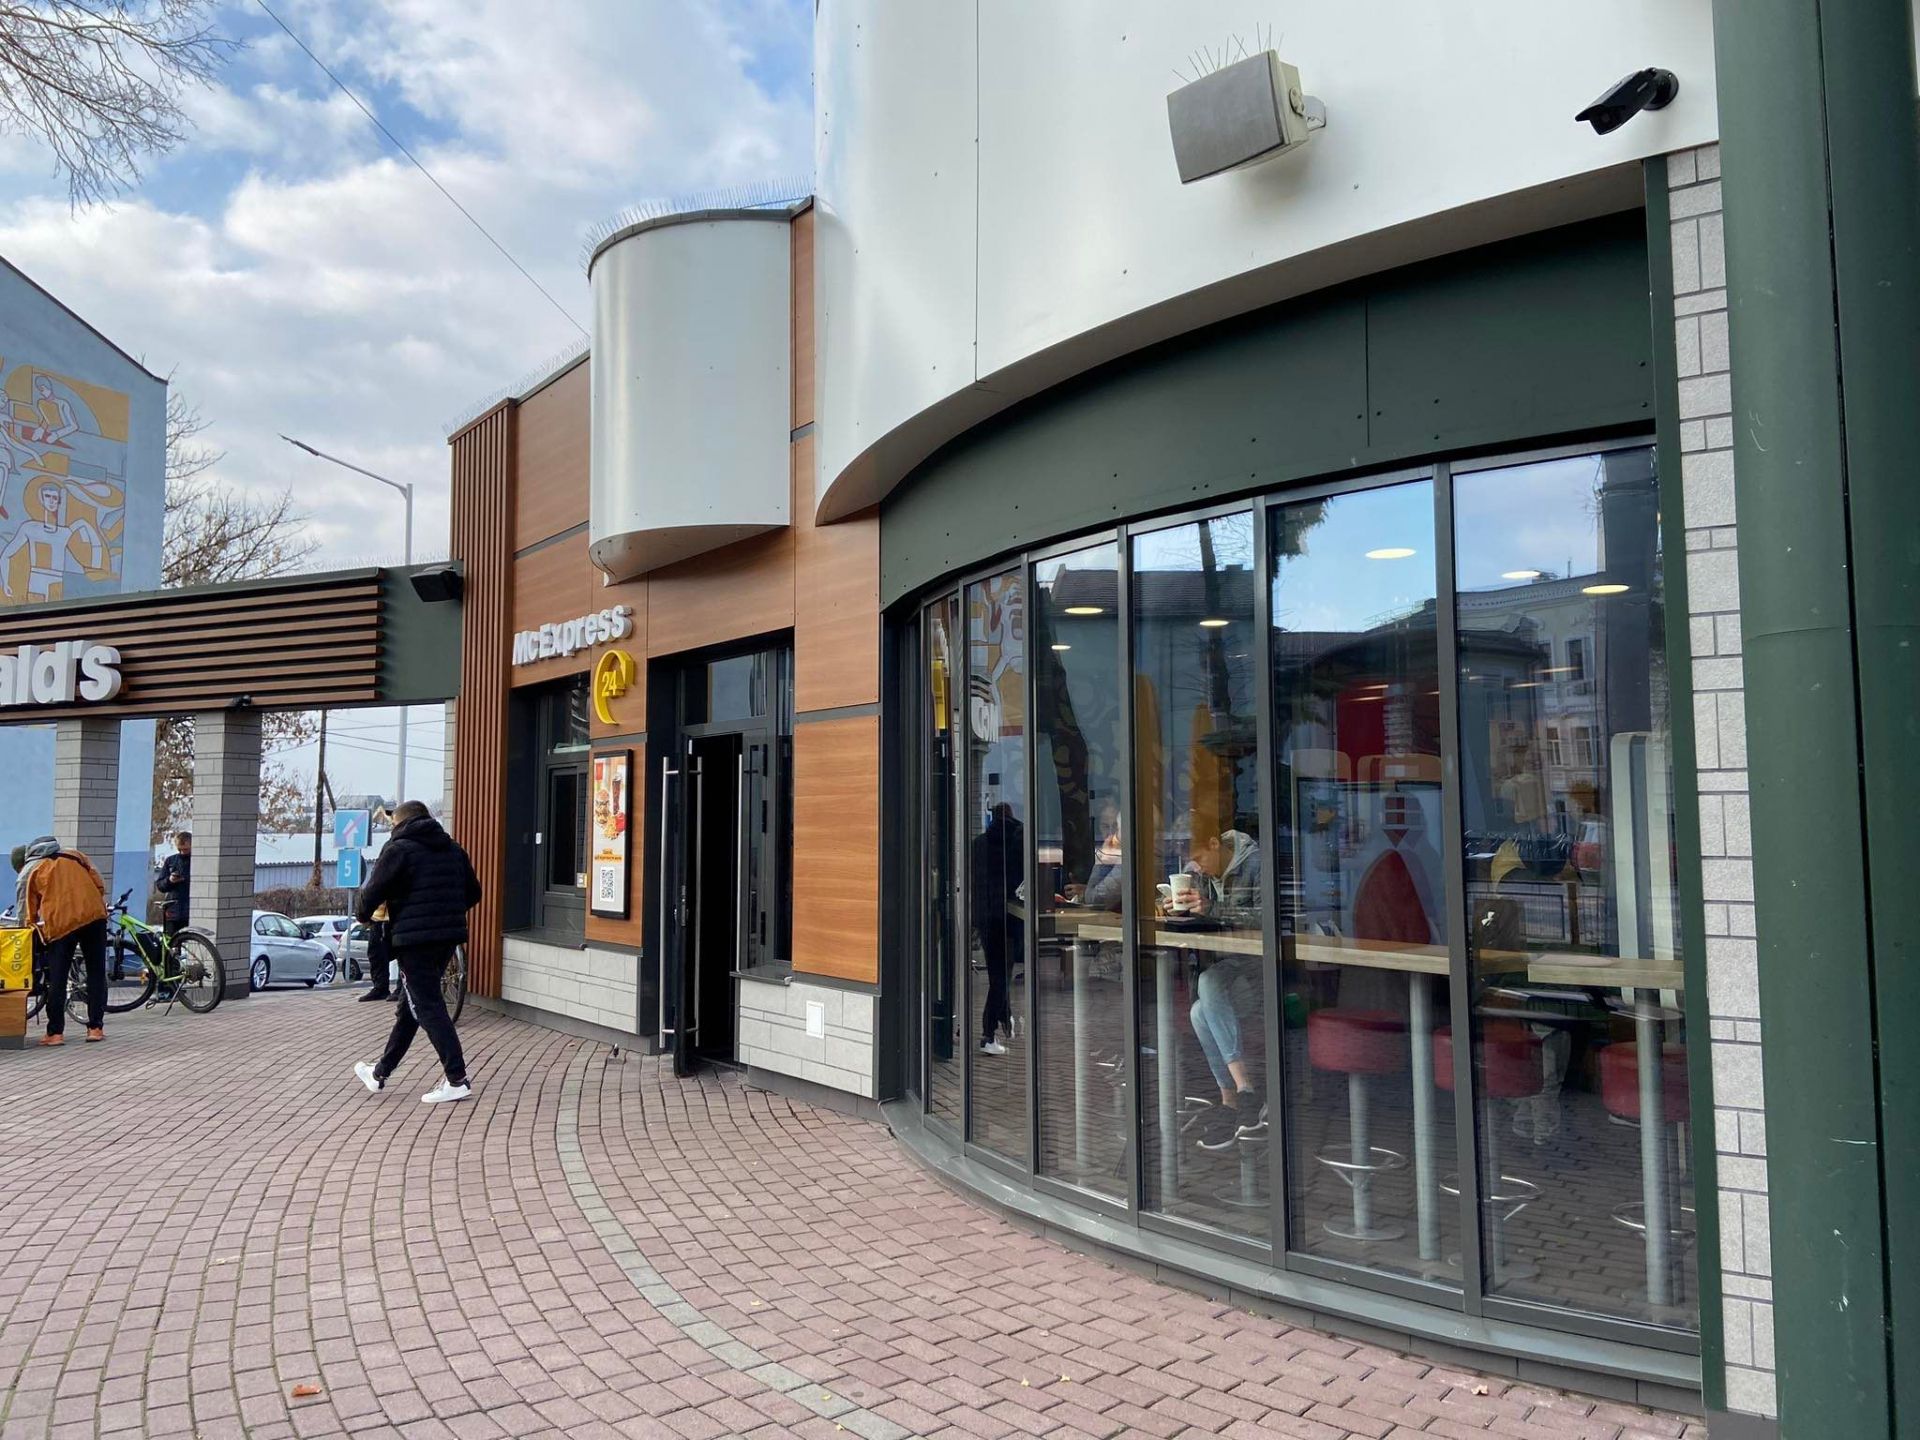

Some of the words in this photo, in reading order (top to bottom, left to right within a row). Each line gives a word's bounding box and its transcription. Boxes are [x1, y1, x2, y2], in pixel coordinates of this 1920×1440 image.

[512, 604, 632, 666] McExpress
[602, 670, 619, 697] 24
[344, 860, 352, 877] 5
[11, 938, 22, 972] Glovo
